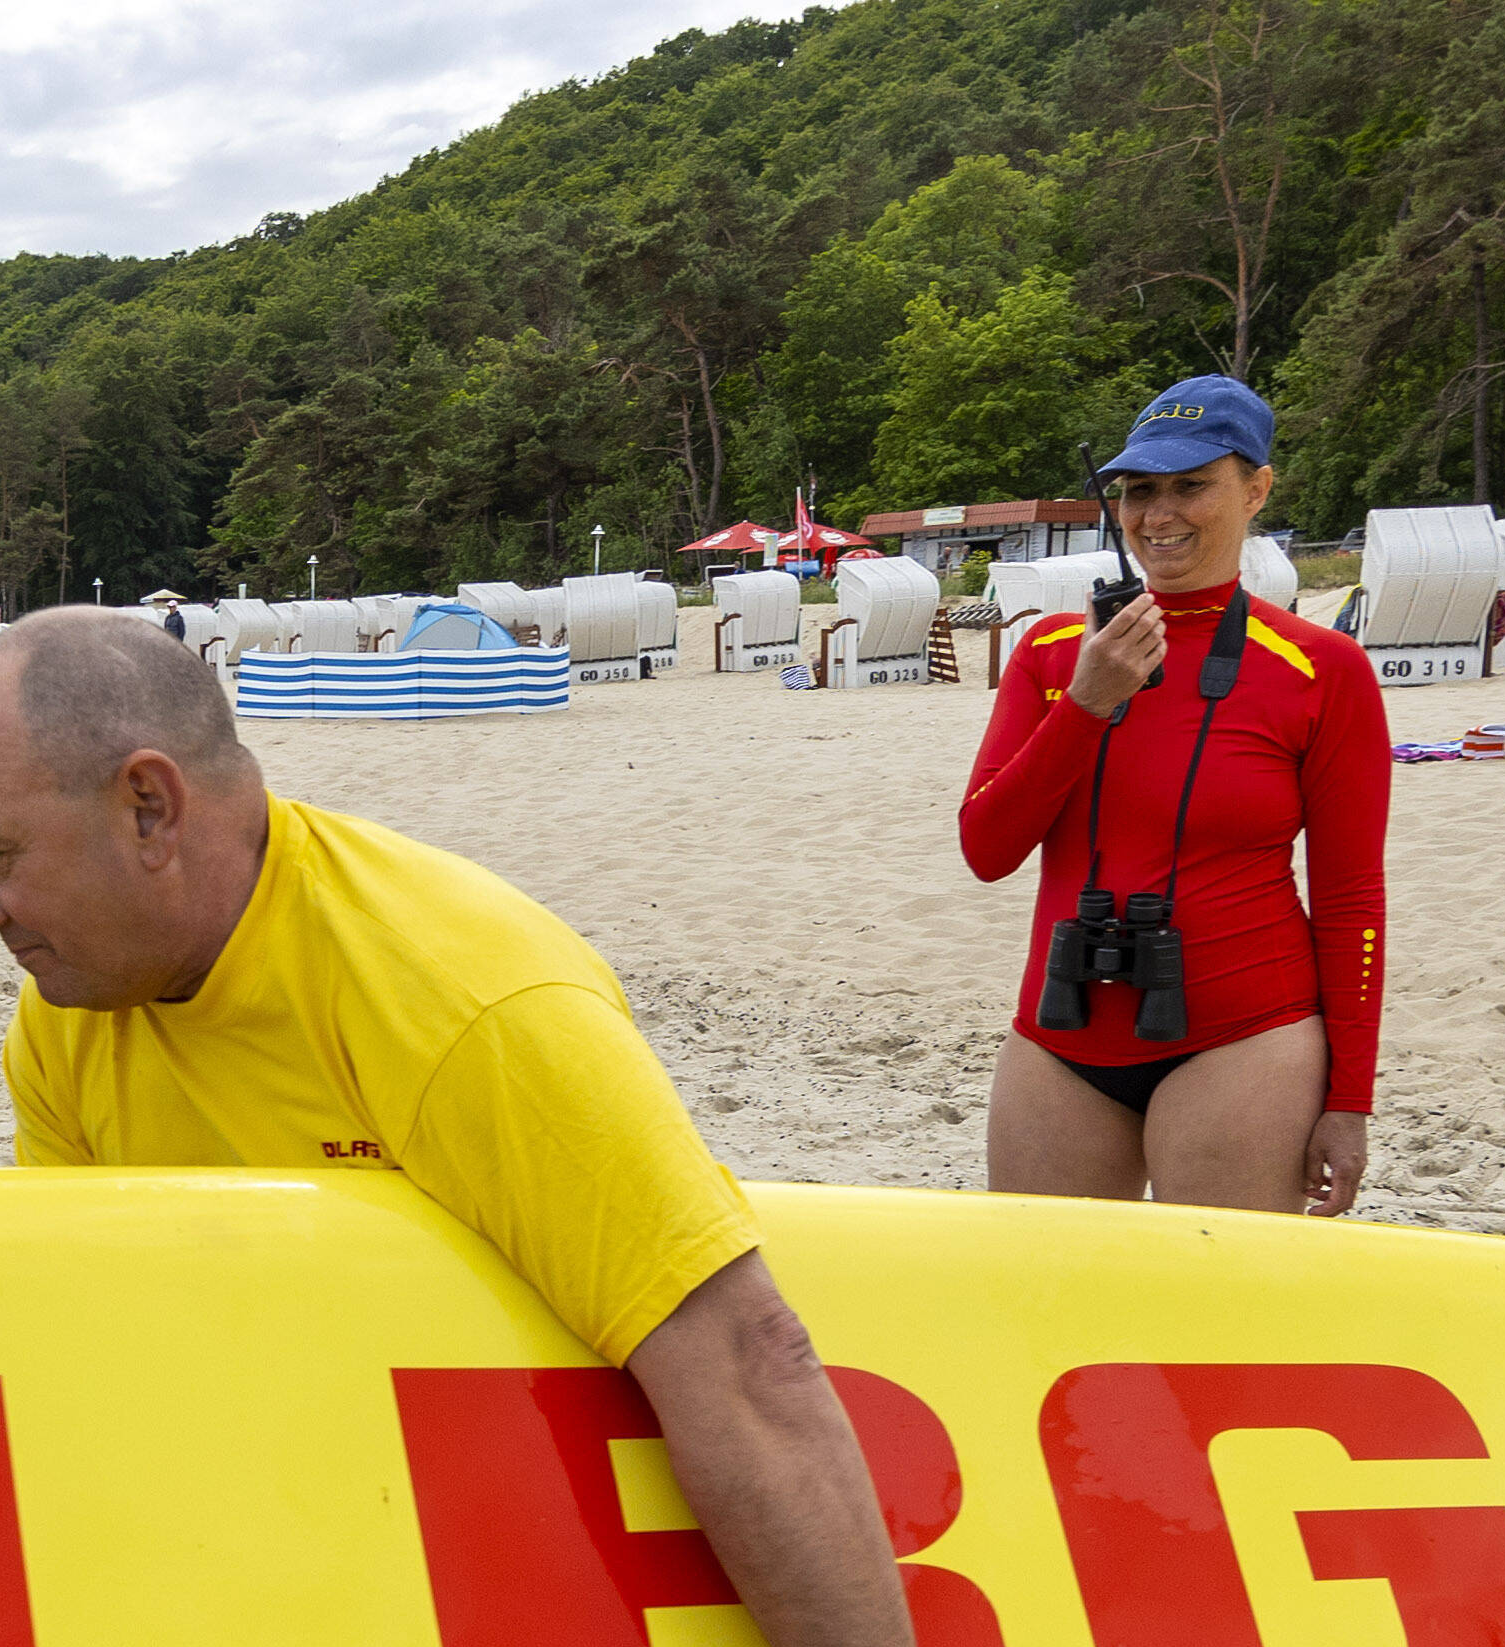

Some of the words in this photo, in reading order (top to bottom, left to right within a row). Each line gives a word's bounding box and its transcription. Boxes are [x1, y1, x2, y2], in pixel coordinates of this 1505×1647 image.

[753, 655, 769, 667] GO
[1382, 660, 1412, 678] GO
[1423, 659, 1465, 676] 319
[580, 670, 598, 682] GO
[604, 667, 629, 680] 350
[869, 670, 888, 685] GO
[894, 668, 919, 682] 329
